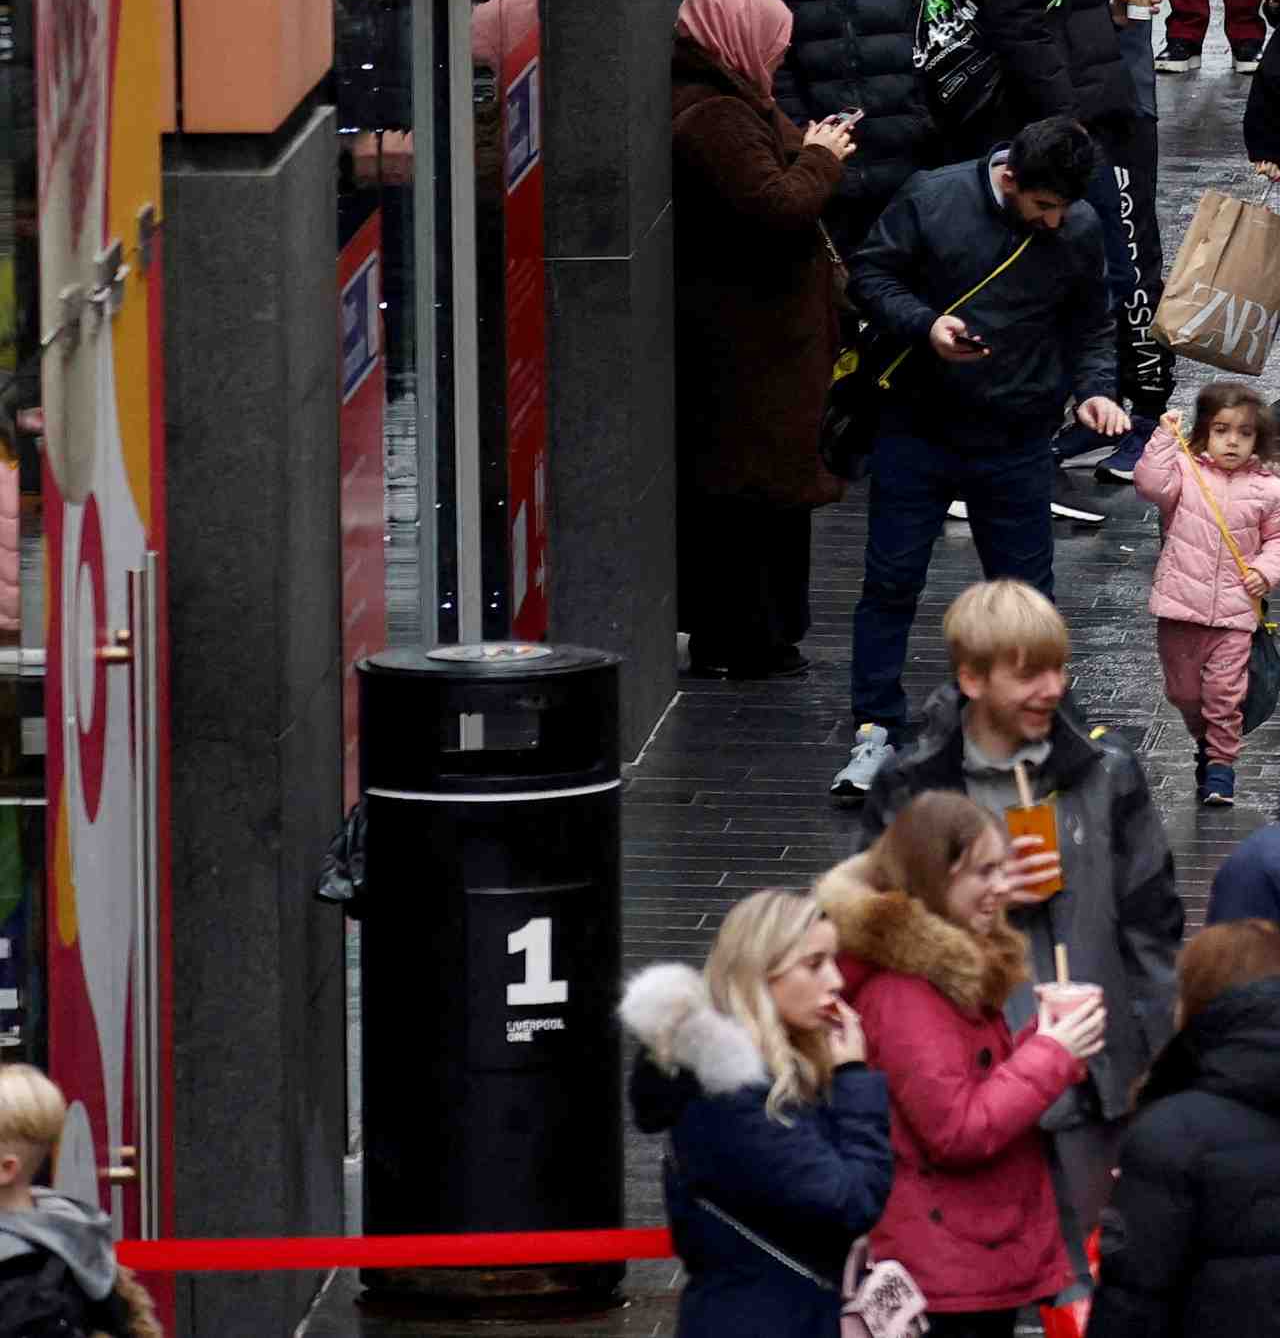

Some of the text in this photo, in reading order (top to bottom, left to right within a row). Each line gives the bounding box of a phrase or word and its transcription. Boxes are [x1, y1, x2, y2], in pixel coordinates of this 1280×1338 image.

[506, 916, 568, 1006] 1
[506, 1018, 566, 1032] LIVERPOOL
[506, 1031, 533, 1042] ONE
